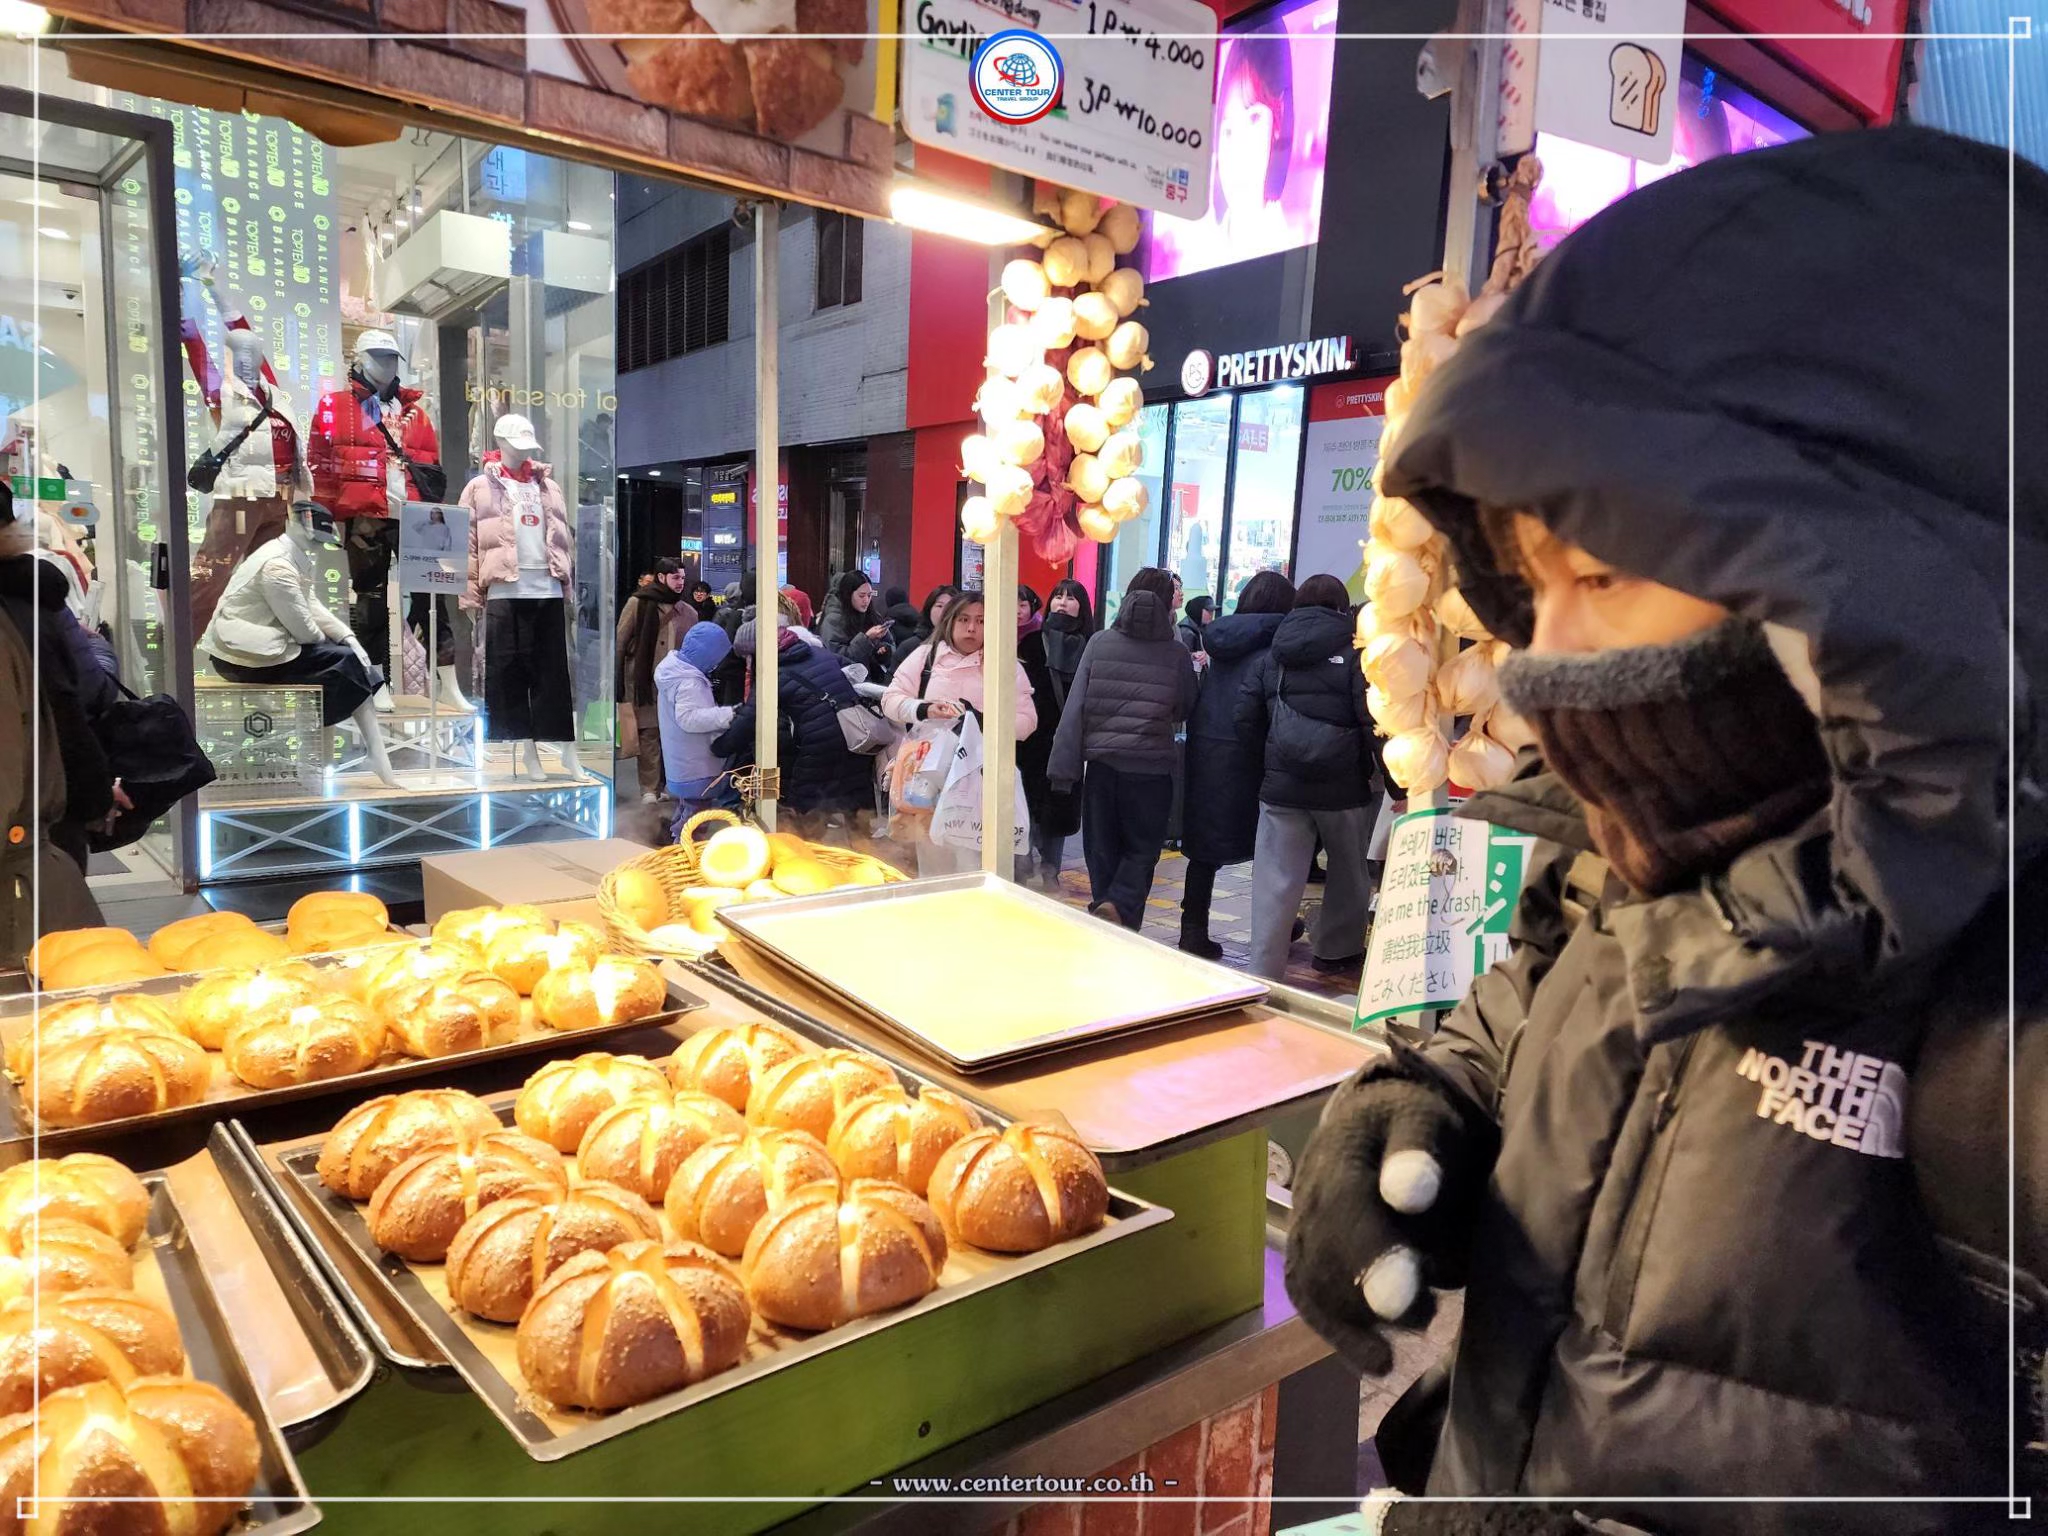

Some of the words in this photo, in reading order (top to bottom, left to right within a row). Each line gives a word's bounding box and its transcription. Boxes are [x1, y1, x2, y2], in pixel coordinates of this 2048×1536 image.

[1217, 336, 1352, 387] PRETTYSKIN.
[1332, 466, 1373, 492] 70%
[219, 771, 299, 782] BALANCE
[1397, 829, 1431, 857] 쓰레기
[1434, 825, 1462, 850] 버려
[1395, 902, 1413, 920] me
[1418, 894, 1438, 916] the
[1736, 1047, 1876, 1121] NORTH
[1802, 1040, 1883, 1092] THE
[1756, 1087, 1867, 1150] FACE
